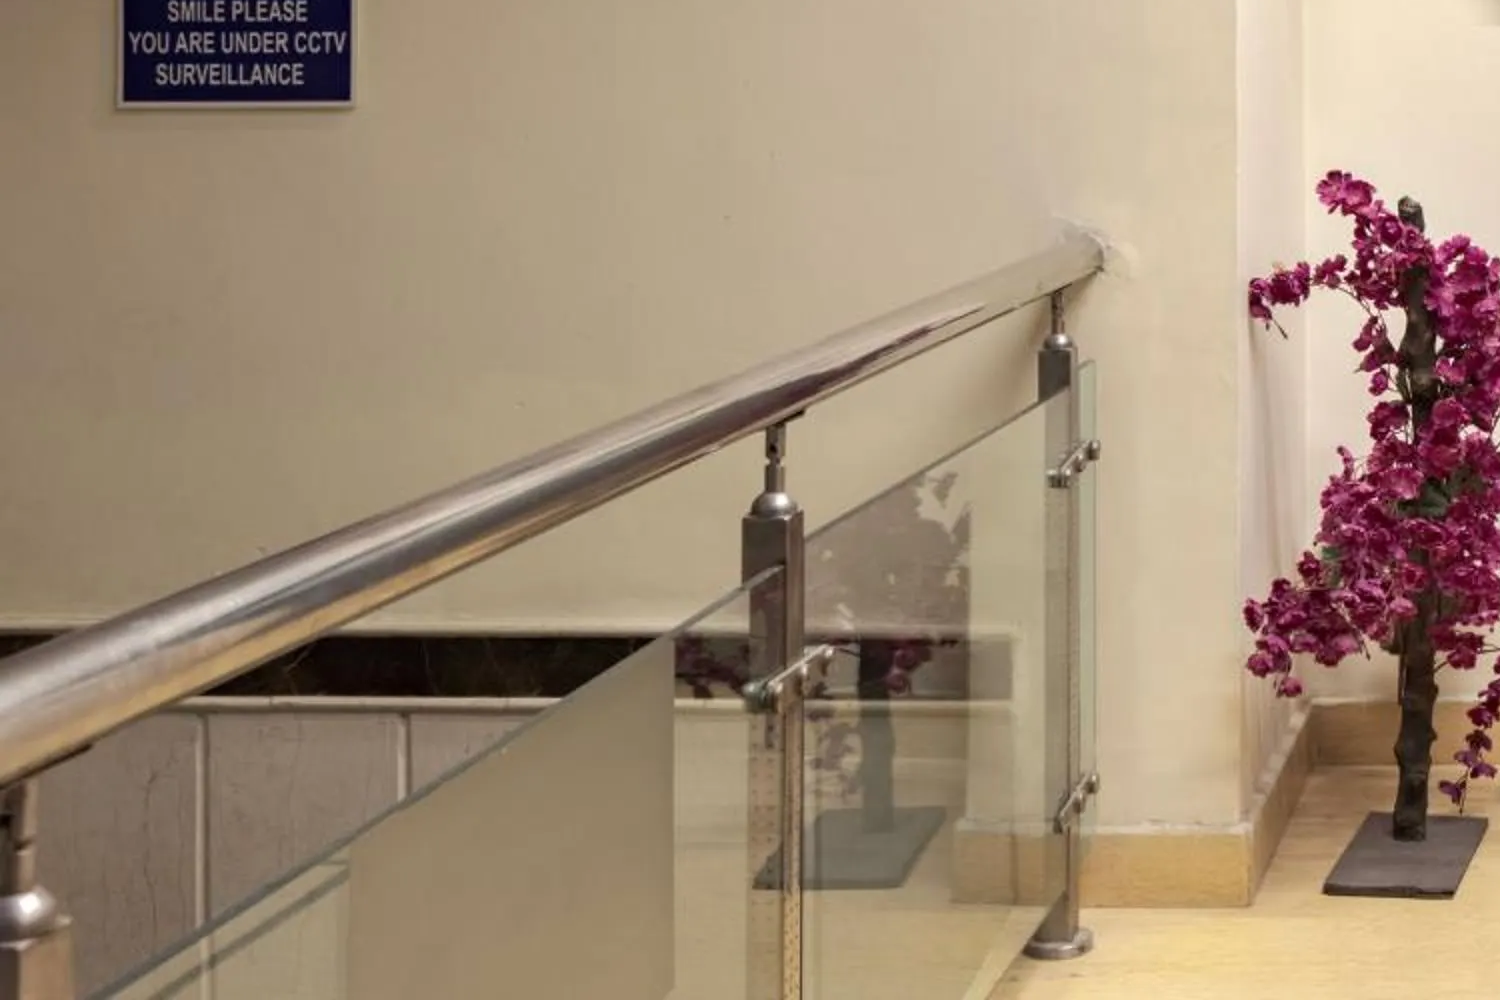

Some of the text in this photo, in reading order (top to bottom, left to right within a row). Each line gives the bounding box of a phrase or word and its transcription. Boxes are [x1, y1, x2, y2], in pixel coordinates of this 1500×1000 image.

[167, 0, 308, 22] SMILE PLEASE
[129, 31, 347, 54] YOU ARE UNDER CCTV
[155, 62, 305, 86] SURVEILLANCE
